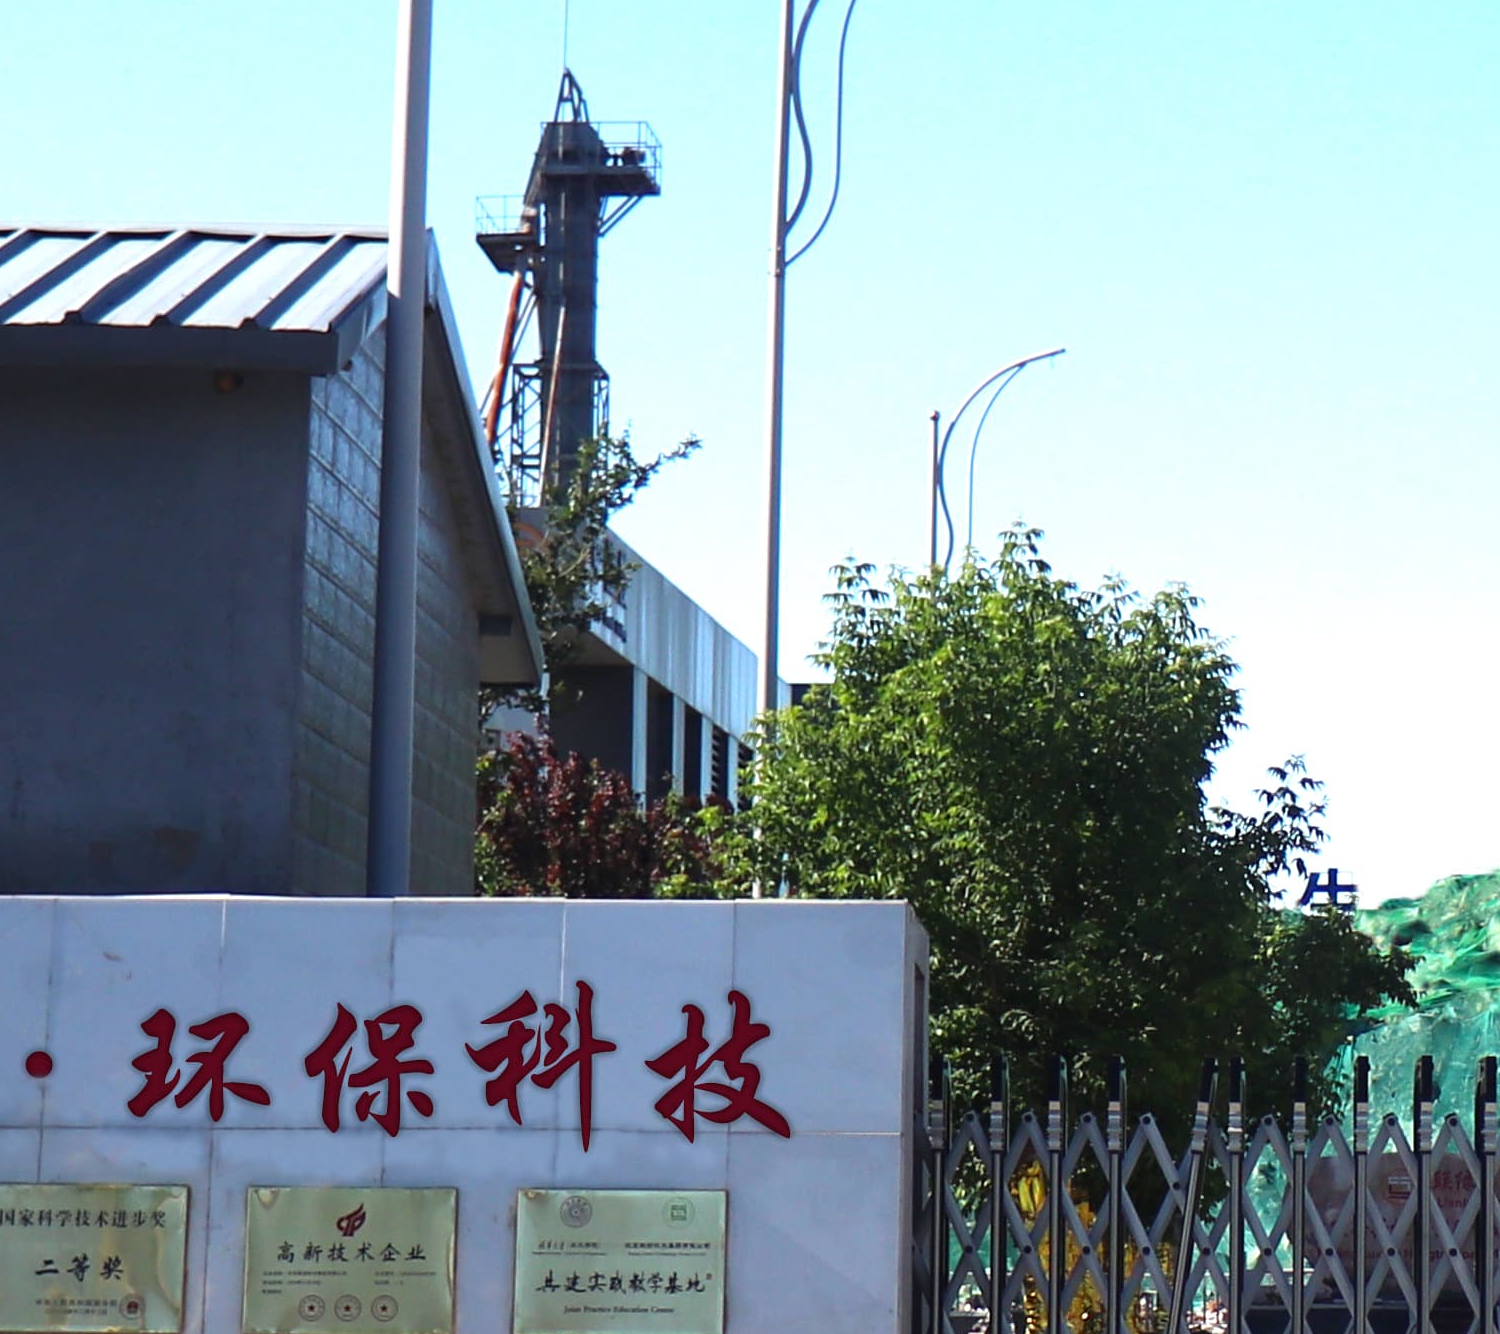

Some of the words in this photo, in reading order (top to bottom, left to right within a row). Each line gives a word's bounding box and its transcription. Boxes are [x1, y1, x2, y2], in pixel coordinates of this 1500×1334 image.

[277, 1241, 427, 1263] 高新技术企业
[35, 1252, 124, 1282] 二等奖
[536, 1269, 706, 1295] 共建实践教学基地
